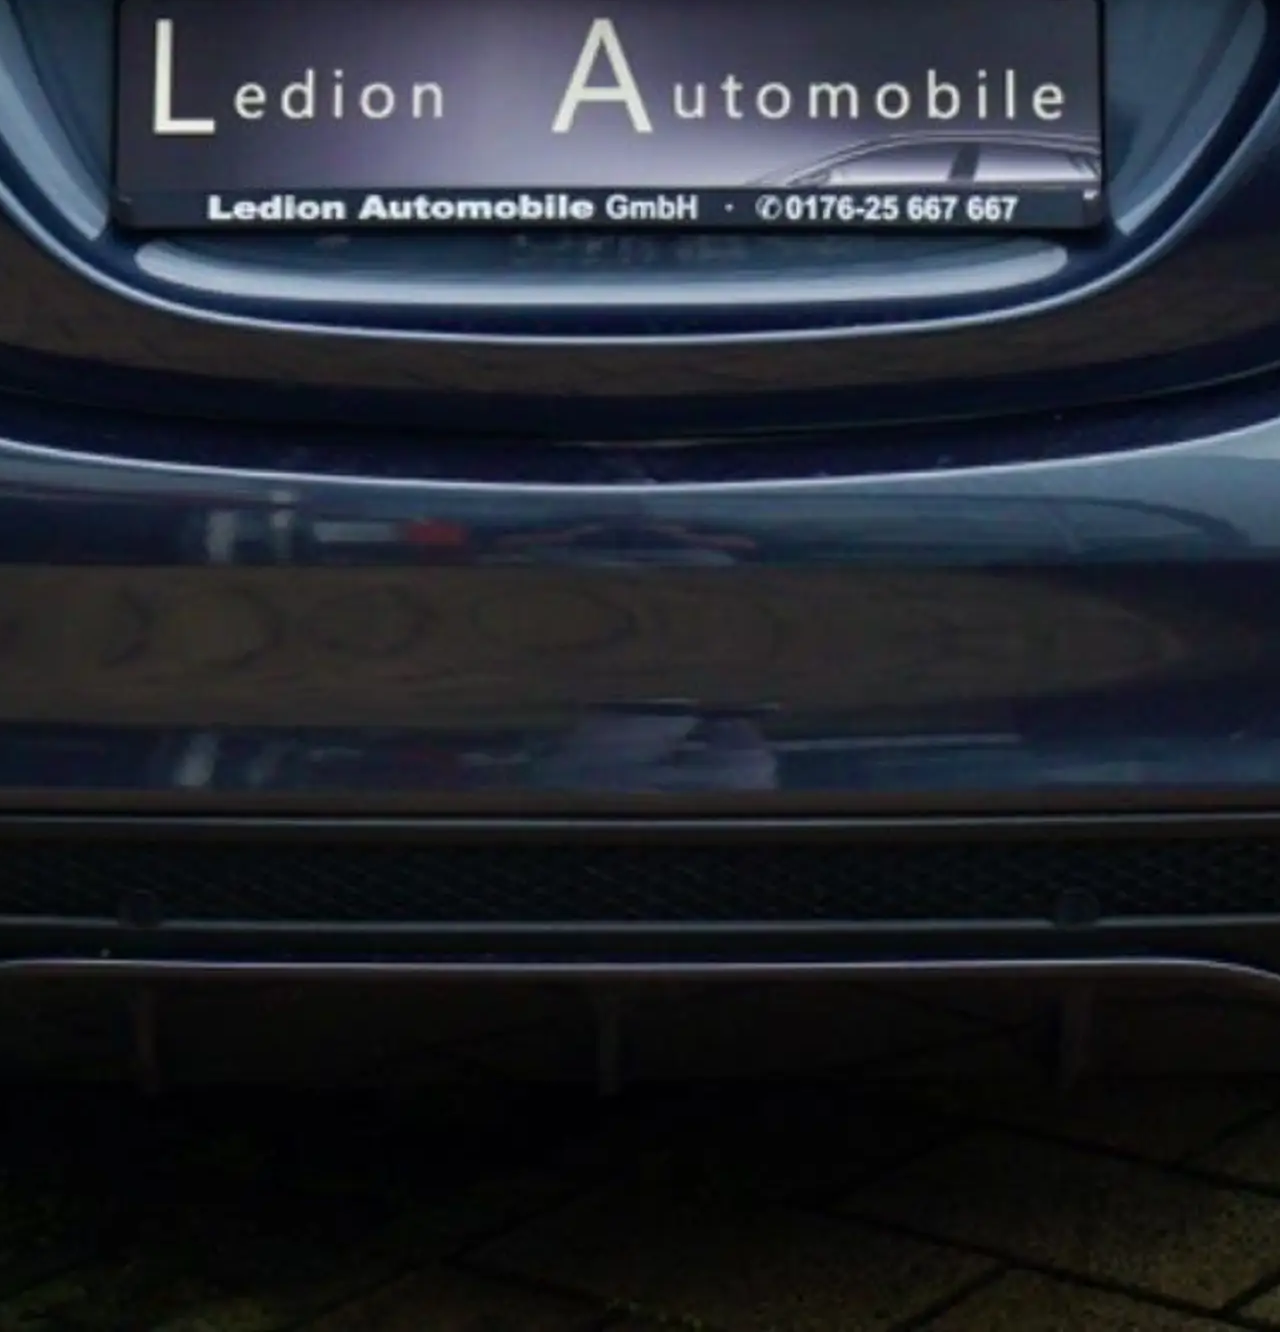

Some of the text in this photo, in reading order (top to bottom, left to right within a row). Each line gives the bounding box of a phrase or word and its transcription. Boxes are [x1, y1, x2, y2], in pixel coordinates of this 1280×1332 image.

[153, 17, 1066, 134] Ledion Automobile
[207, 193, 347, 222] Ledion
[358, 193, 595, 222] Automobile
[605, 193, 699, 222] GmbH
[906, 194, 958, 222] 667
[966, 194, 1019, 222] 667
